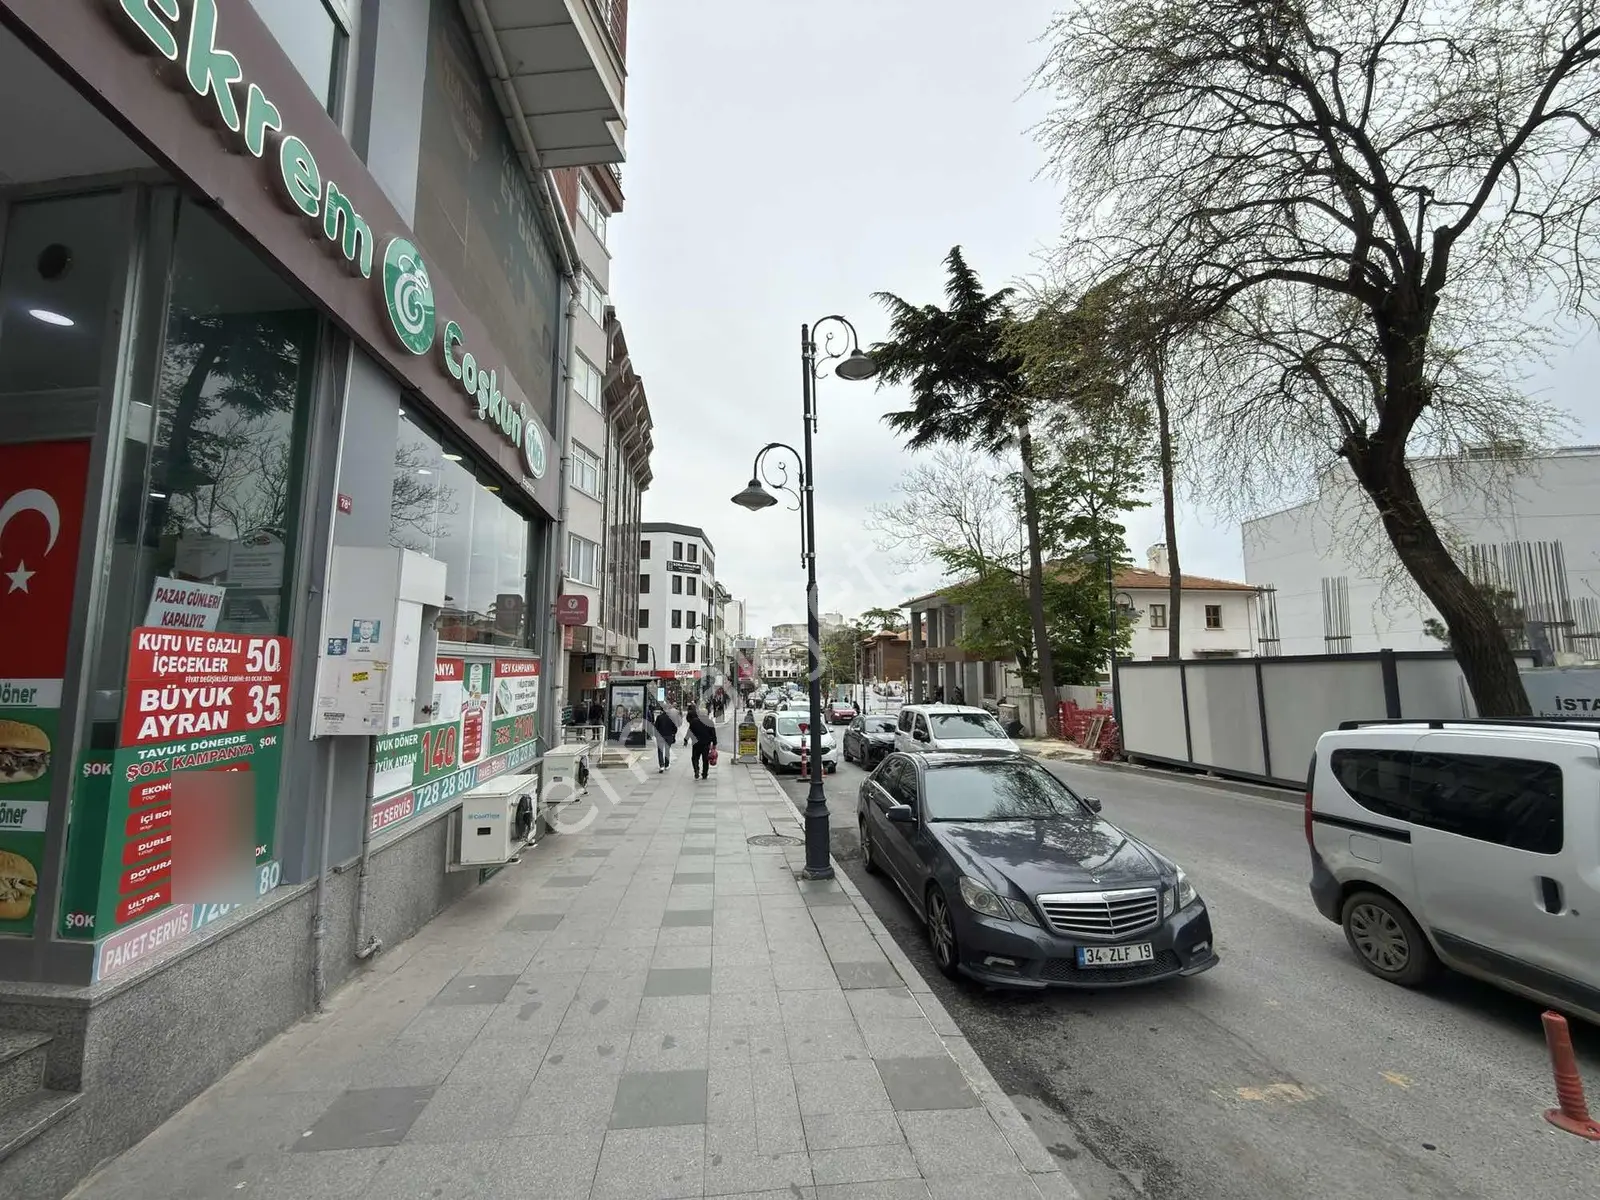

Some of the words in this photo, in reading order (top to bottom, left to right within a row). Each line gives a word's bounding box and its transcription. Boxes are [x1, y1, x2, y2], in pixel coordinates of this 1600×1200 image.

[155, 587, 187, 606] PAZAR
[187, 588, 223, 610] GÜNLERİ
[160, 610, 207, 629] KAPALIYIZ
[138, 633, 183, 652] KUTU
[186, 636, 204, 652] VE
[206, 637, 242, 654] GAZLI
[152, 652, 228, 677] İÇECEKLER
[0, 682, 37, 704] öner
[139, 684, 234, 712] BÜYÜK
[137, 710, 230, 740] AYRAN
[137, 743, 187, 760] TAVUK
[192, 734, 247, 751] DÖNERDE
[259, 735, 277, 748] ŞOK
[394, 733, 418, 749] DÖNER
[82, 762, 113, 777] ŞOK
[126, 761, 167, 782] ŞOK
[171, 744, 255, 771] KAMPANYA
[393, 752, 418, 769] AYRAN
[383, 797, 411, 824] SERVİS
[416, 781, 440, 813] 728
[441, 775, 456, 799] 28
[140, 812, 154, 825] İÇİ
[127, 892, 161, 911] ULTRA
[66, 913, 95, 930] ŞOK
[103, 930, 148, 973] PAKET
[149, 910, 189, 951] SERVİS
[1086, 948, 1103, 963] 34
[1109, 946, 1131, 962] ZLF
[1138, 944, 1151, 960] 19
